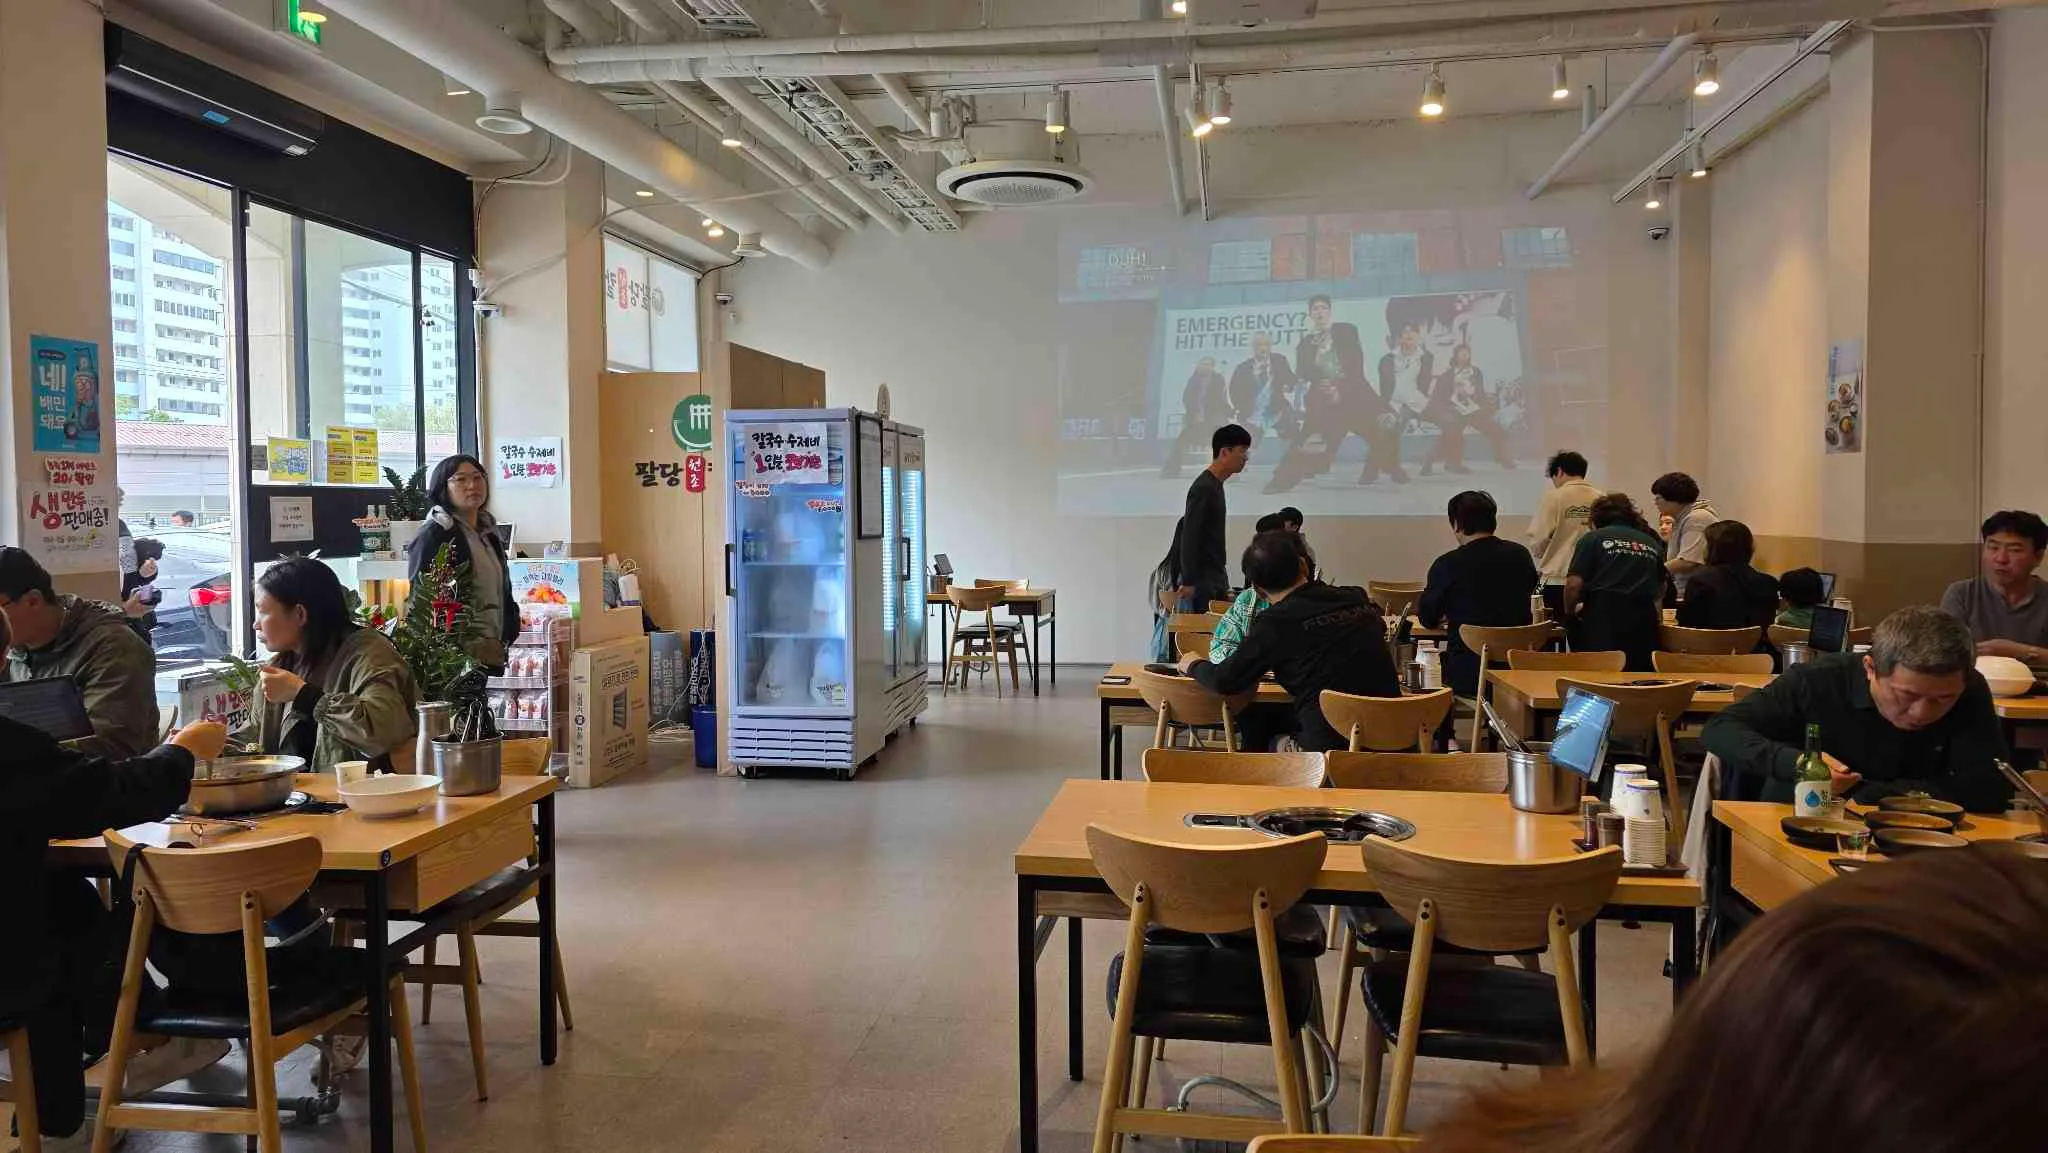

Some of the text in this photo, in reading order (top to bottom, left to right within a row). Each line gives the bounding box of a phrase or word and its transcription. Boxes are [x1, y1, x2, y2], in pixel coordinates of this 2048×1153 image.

[1176, 313, 1307, 334] EMERGENCY?
[1174, 333, 1207, 350] HIT
[1210, 331, 1249, 348] THE
[40, 362, 66, 392] 네!
[40, 396, 65, 412] 배민
[752, 432, 821, 449] 칼국수 수제비
[501, 445, 556, 459] 칼국수 수제비
[635, 461, 683, 487] 팔당
[61, 507, 108, 530] 판매중!
